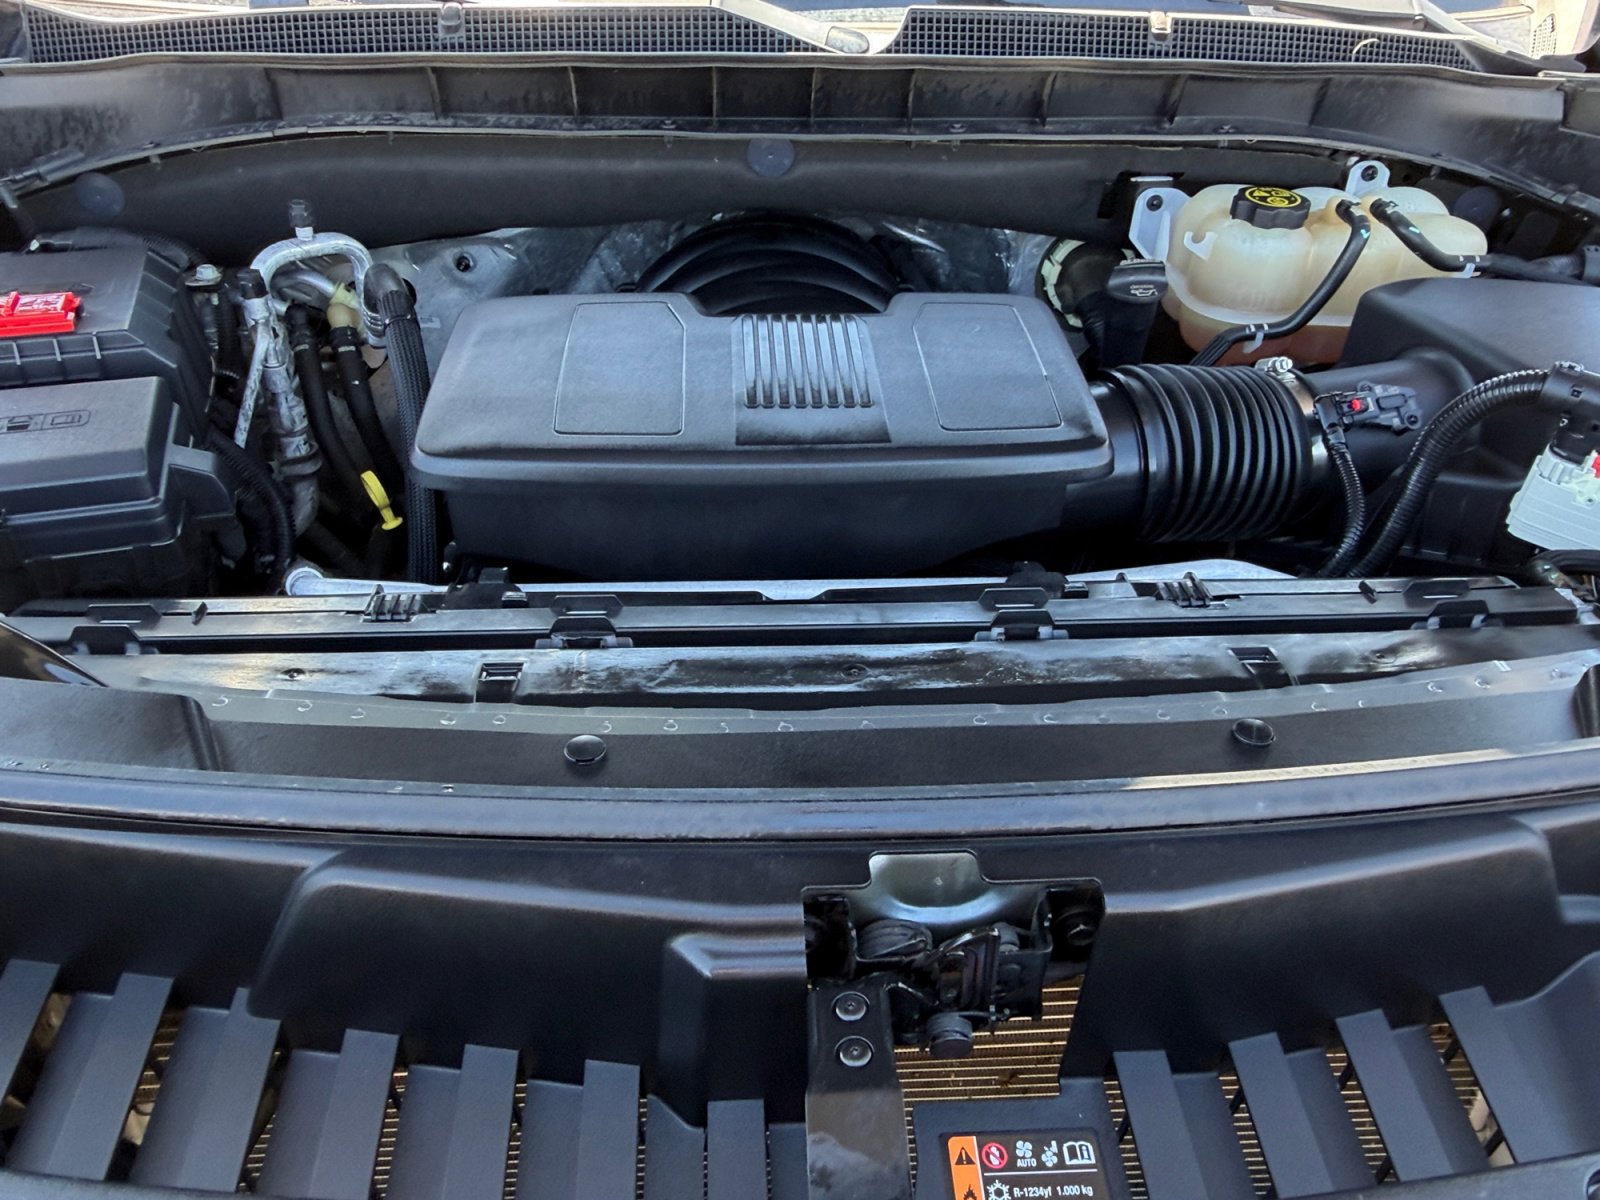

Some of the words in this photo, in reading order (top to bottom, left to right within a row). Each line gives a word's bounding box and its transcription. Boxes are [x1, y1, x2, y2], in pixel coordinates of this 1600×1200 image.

[1016, 1158, 1037, 1168] AUTO
[1013, 1186, 1052, 1198] R-1234yf
[1056, 1185, 1080, 1196] 1.000
[1081, 1185, 1093, 1196] kg
